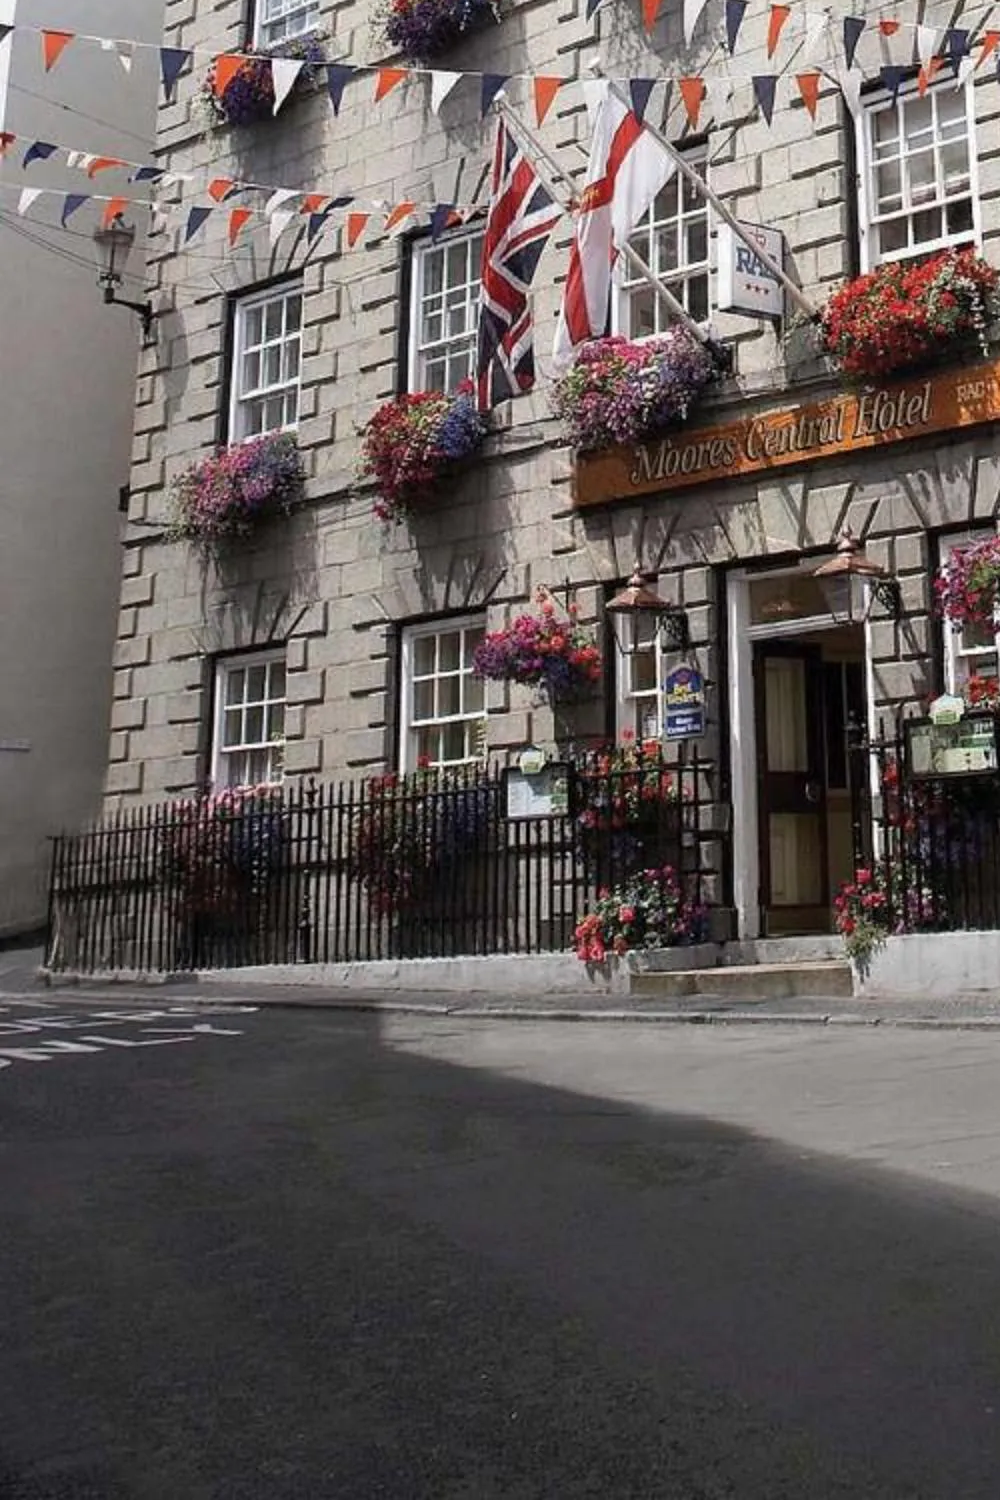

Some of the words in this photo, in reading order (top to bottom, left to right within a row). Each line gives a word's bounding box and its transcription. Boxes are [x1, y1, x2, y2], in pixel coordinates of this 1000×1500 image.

[957, 381, 986, 402] RAC
[631, 436, 736, 484] Moores
[746, 404, 845, 459] Central
[854, 382, 931, 437] Hotel
